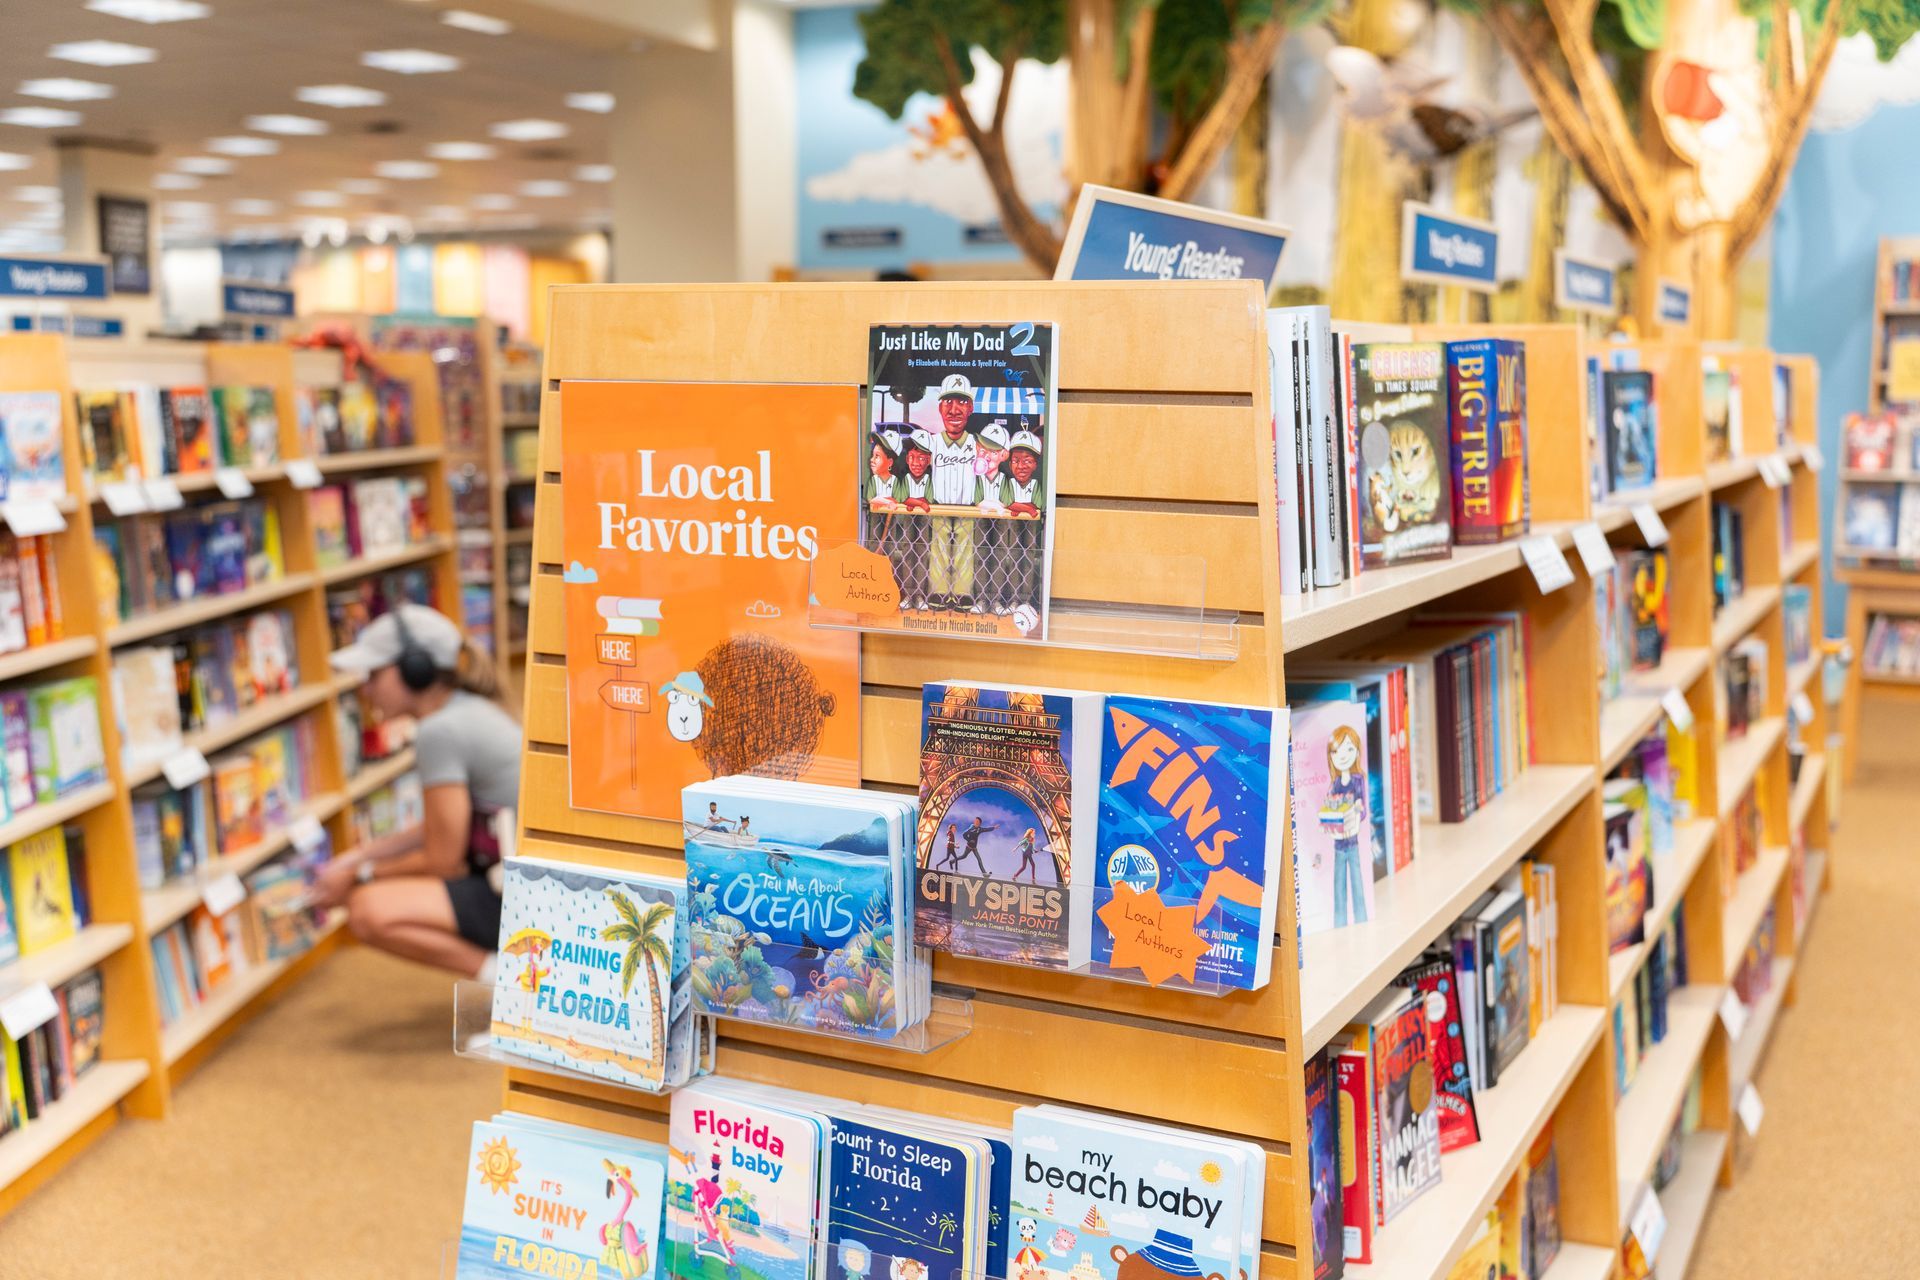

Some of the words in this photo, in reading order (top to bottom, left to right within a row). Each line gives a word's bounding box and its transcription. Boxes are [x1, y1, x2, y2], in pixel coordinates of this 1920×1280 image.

[1124, 231, 1182, 279] Young
[1177, 240, 1245, 279] Readers
[879, 331, 907, 351] Just
[911, 332, 941, 351] Like
[946, 332, 969, 356] My
[973, 331, 1004, 351] Dad
[1009, 322, 1040, 357] 2
[908, 358, 915, 367] By
[916, 358, 940, 367] Elizabeth
[949, 359, 971, 368] Johnson
[978, 360, 993, 369] Tyrell
[1374, 382, 1383, 393] IN
[1386, 380, 1407, 393] TIMES
[1410, 379, 1438, 392] SQUARE
[1458, 356, 1488, 417] BIG
[935, 453, 975, 467] Coach
[1461, 421, 1491, 518] TREE
[637, 449, 774, 502] Local
[597, 502, 819, 561] Favorites
[841, 562, 877, 582] Local
[845, 585, 890, 603] Authors
[903, 616, 938, 630] Illustrated
[940, 619, 948, 631] by
[949, 619, 974, 633] Nicolas
[601, 640, 631, 661] HERE
[612, 685, 644, 705] THERE
[937, 729, 980, 739] GRIN-INDUCING
[1109, 727, 1239, 866] FINS
[759, 873, 782, 891] Tell
[786, 879, 807, 895] Me
[808, 877, 846, 897] About
[921, 872, 983, 907] CITY
[984, 881, 1063, 919] SPIES
[723, 872, 853, 938] OCEANS
[1125, 903, 1163, 931] Local
[577, 925, 596, 940] IT'S
[961, 919, 974, 927] New
[975, 920, 988, 928] York
[988, 923, 1005, 931] Times
[1005, 926, 1038, 938] Bestselling
[1038, 931, 1058, 939] Author
[972, 909, 1016, 925] JAMES
[1018, 915, 1059, 931] PONTI
[1135, 929, 1183, 959] Authors
[1211, 930, 1238, 942] AUTHOR
[551, 939, 621, 974] RAINING
[579, 973, 590, 986] IN
[537, 985, 630, 1031] FLORIDA
[693, 1110, 784, 1158] Florida
[732, 1146, 783, 1183] baby
[878, 1139, 896, 1158] to
[903, 1145, 952, 1177] Sleep
[1082, 1150, 1113, 1172] my
[851, 1153, 922, 1192] Florida
[1383, 1142, 1440, 1210] MAGEE
[541, 1179, 562, 1195] IT'S
[1025, 1153, 1127, 1204] beach
[1137, 1177, 1223, 1229] baby
[514, 1193, 587, 1231] SUNNY
[880, 1197, 890, 1211] 2
[925, 1211, 938, 1226] 3
[541, 1227, 554, 1241] IN
[494, 1235, 598, 1280] FLORIDA
